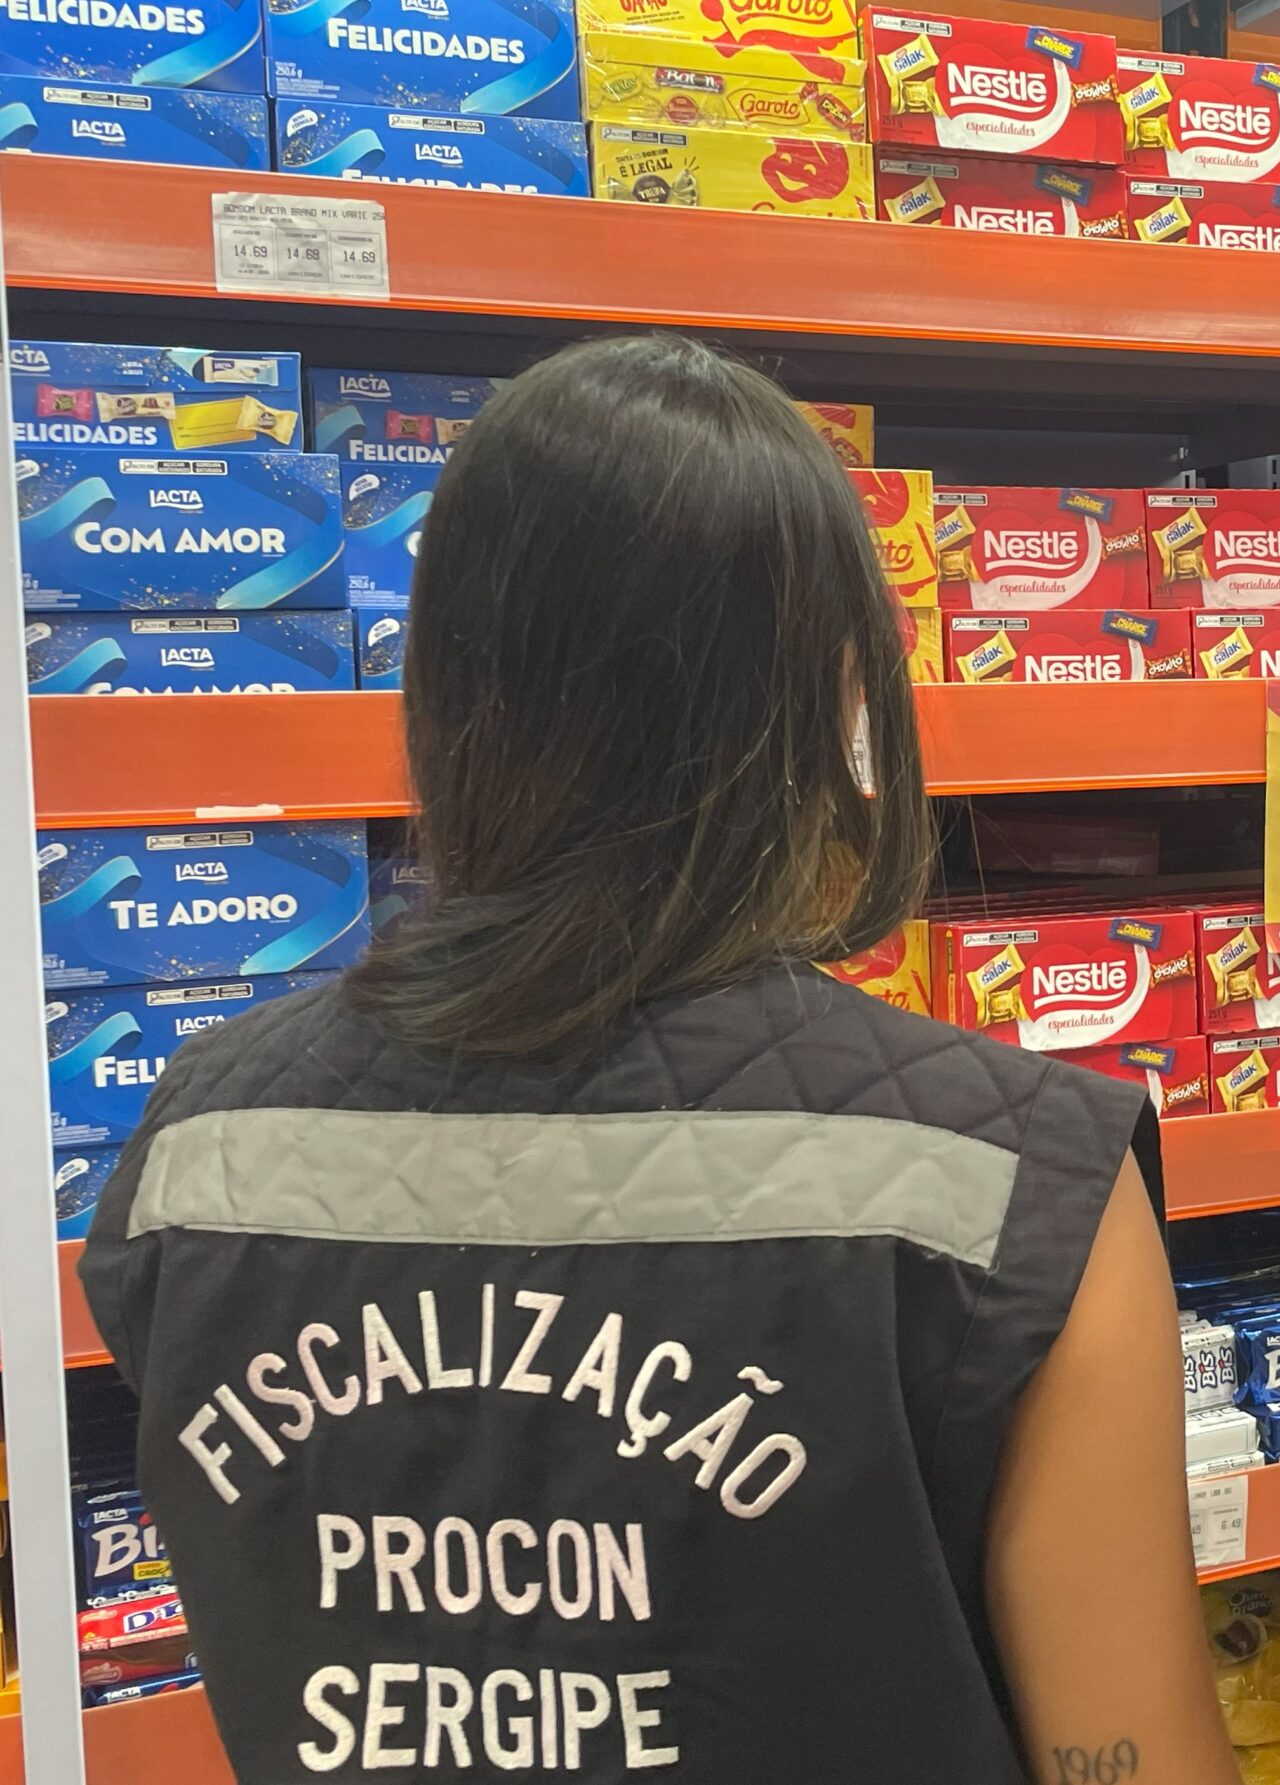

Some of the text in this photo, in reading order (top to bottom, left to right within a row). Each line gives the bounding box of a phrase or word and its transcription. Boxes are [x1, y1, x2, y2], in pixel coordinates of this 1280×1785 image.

[326, 17, 526, 64] FELICIDADES
[893, 48, 926, 71] Galak
[947, 62, 1048, 103] Nestlé
[739, 92, 801, 118] Garoto
[1130, 86, 1160, 109] Galak
[965, 120, 1036, 138] especialidades
[1178, 99, 1272, 136] Nestlé
[72, 119, 127, 142] LACTA
[414, 143, 464, 164] LACTA
[1194, 154, 1260, 169] especialidades
[631, 157, 673, 176] LEGAL
[259, 206, 287, 215] LACTA
[321, 209, 339, 219] MIX
[899, 191, 932, 216] Galak
[954, 204, 1055, 235] Nestlé
[1148, 211, 1179, 235] Galak
[234, 245, 268, 258] 14.69
[287, 247, 320, 261] 14.69
[343, 251, 376, 263] 14.69
[10, 350, 50, 371] CTA
[340, 376, 392, 398] LACTA
[12, 422, 158, 446] ELICIDADES
[349, 440, 453, 464] FELICIDA
[150, 489, 204, 510] LACTA
[74, 521, 287, 554] COM AMOR
[983, 529, 1079, 560] Nestlé
[1166, 521, 1195, 544] Galak
[999, 580, 1066, 596] especialidades
[160, 648, 215, 668] LACTA
[971, 644, 1003, 670] Galak
[1213, 641, 1242, 665] Galak
[1024, 655, 1122, 682] Nestlé
[175, 862, 229, 882] LACTA
[109, 893, 299, 930] TE ADORO
[1219, 941, 1248, 966] Galak
[981, 957, 1013, 985] Galak
[1032, 959, 1128, 996] Nestlé
[1047, 1013, 1115, 1033] especialidades
[1229, 1063, 1258, 1090] Galak
[177, 1283, 807, 1519] FISCALIZAÇÃO
[93, 1507, 129, 1524] LACTA
[90, 1512, 166, 1578] Bi
[316, 1513, 651, 1621] PROCON
[297, 1662, 680, 1773] SERGIPE
[1052, 1736, 1139, 1785] 1969
